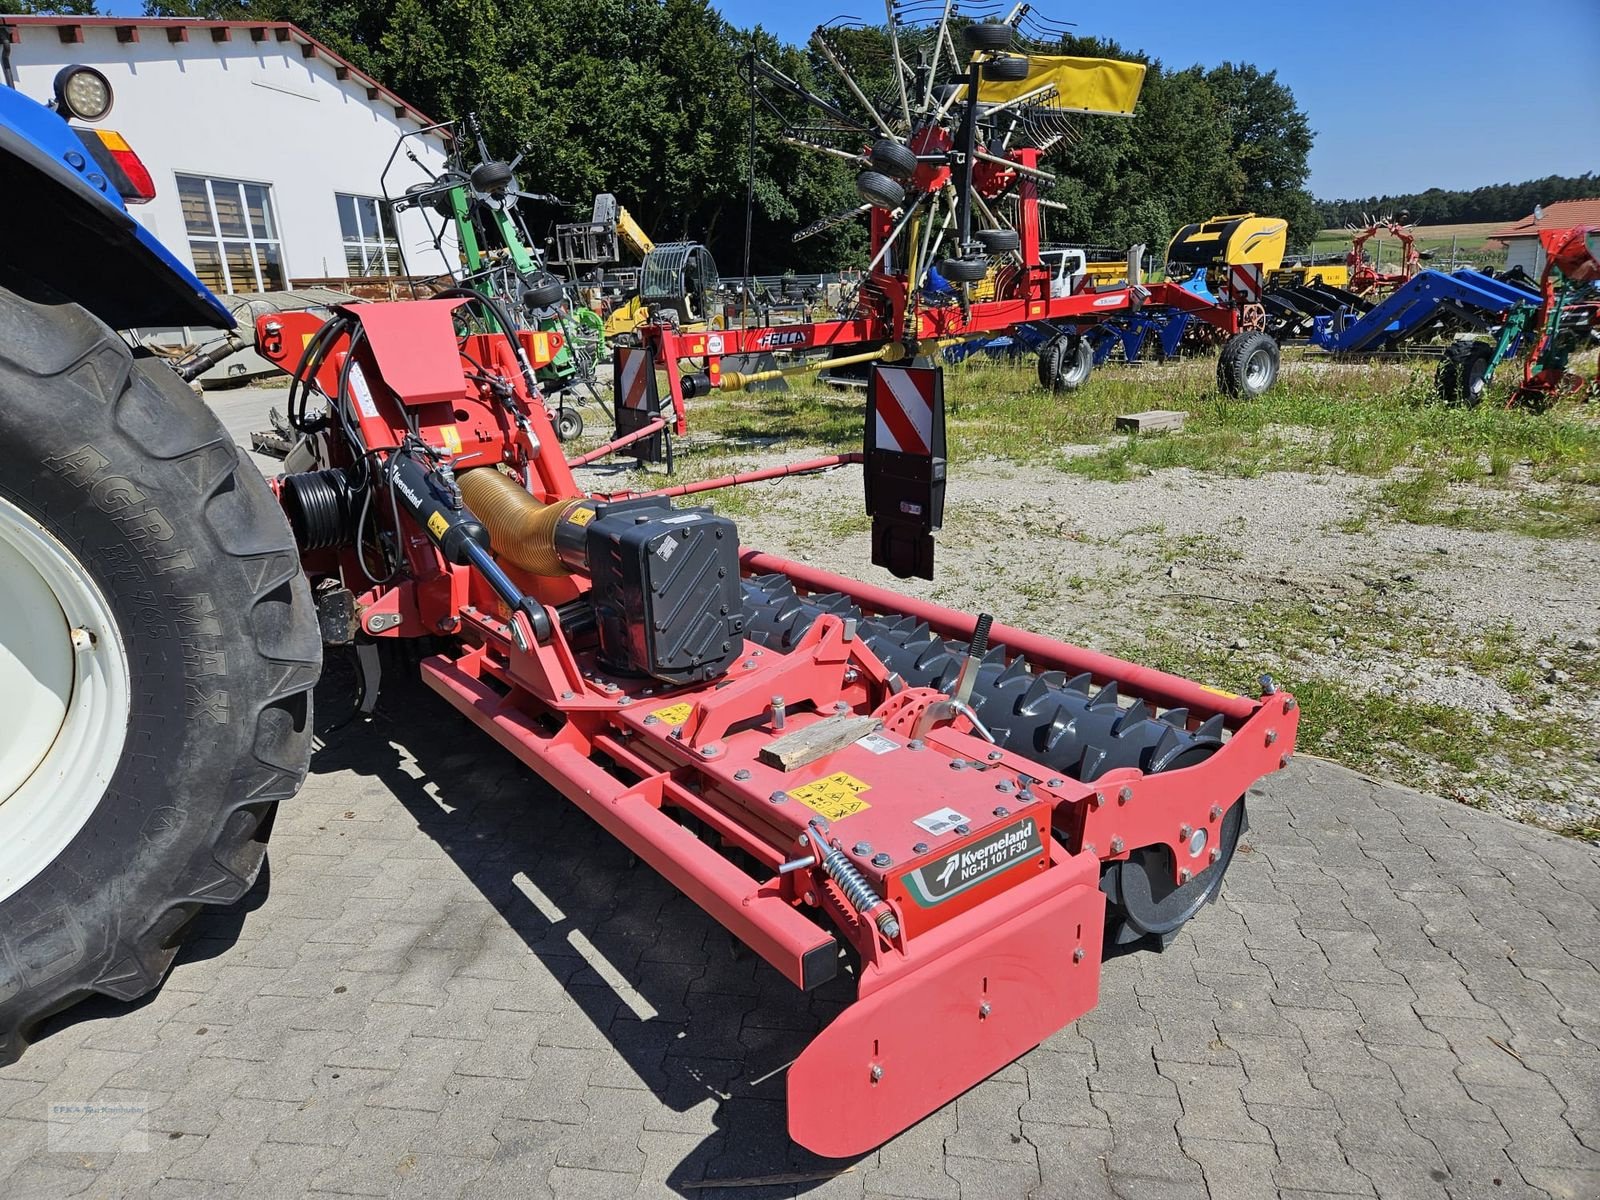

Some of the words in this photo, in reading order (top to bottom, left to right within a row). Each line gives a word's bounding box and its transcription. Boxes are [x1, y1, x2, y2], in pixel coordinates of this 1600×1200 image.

[761, 331, 804, 346] FELLA
[961, 822, 1032, 868] Kverneland
[961, 859, 988, 880] NG-H
[990, 849, 1007, 865] 101
[1010, 839, 1028, 856] F30
